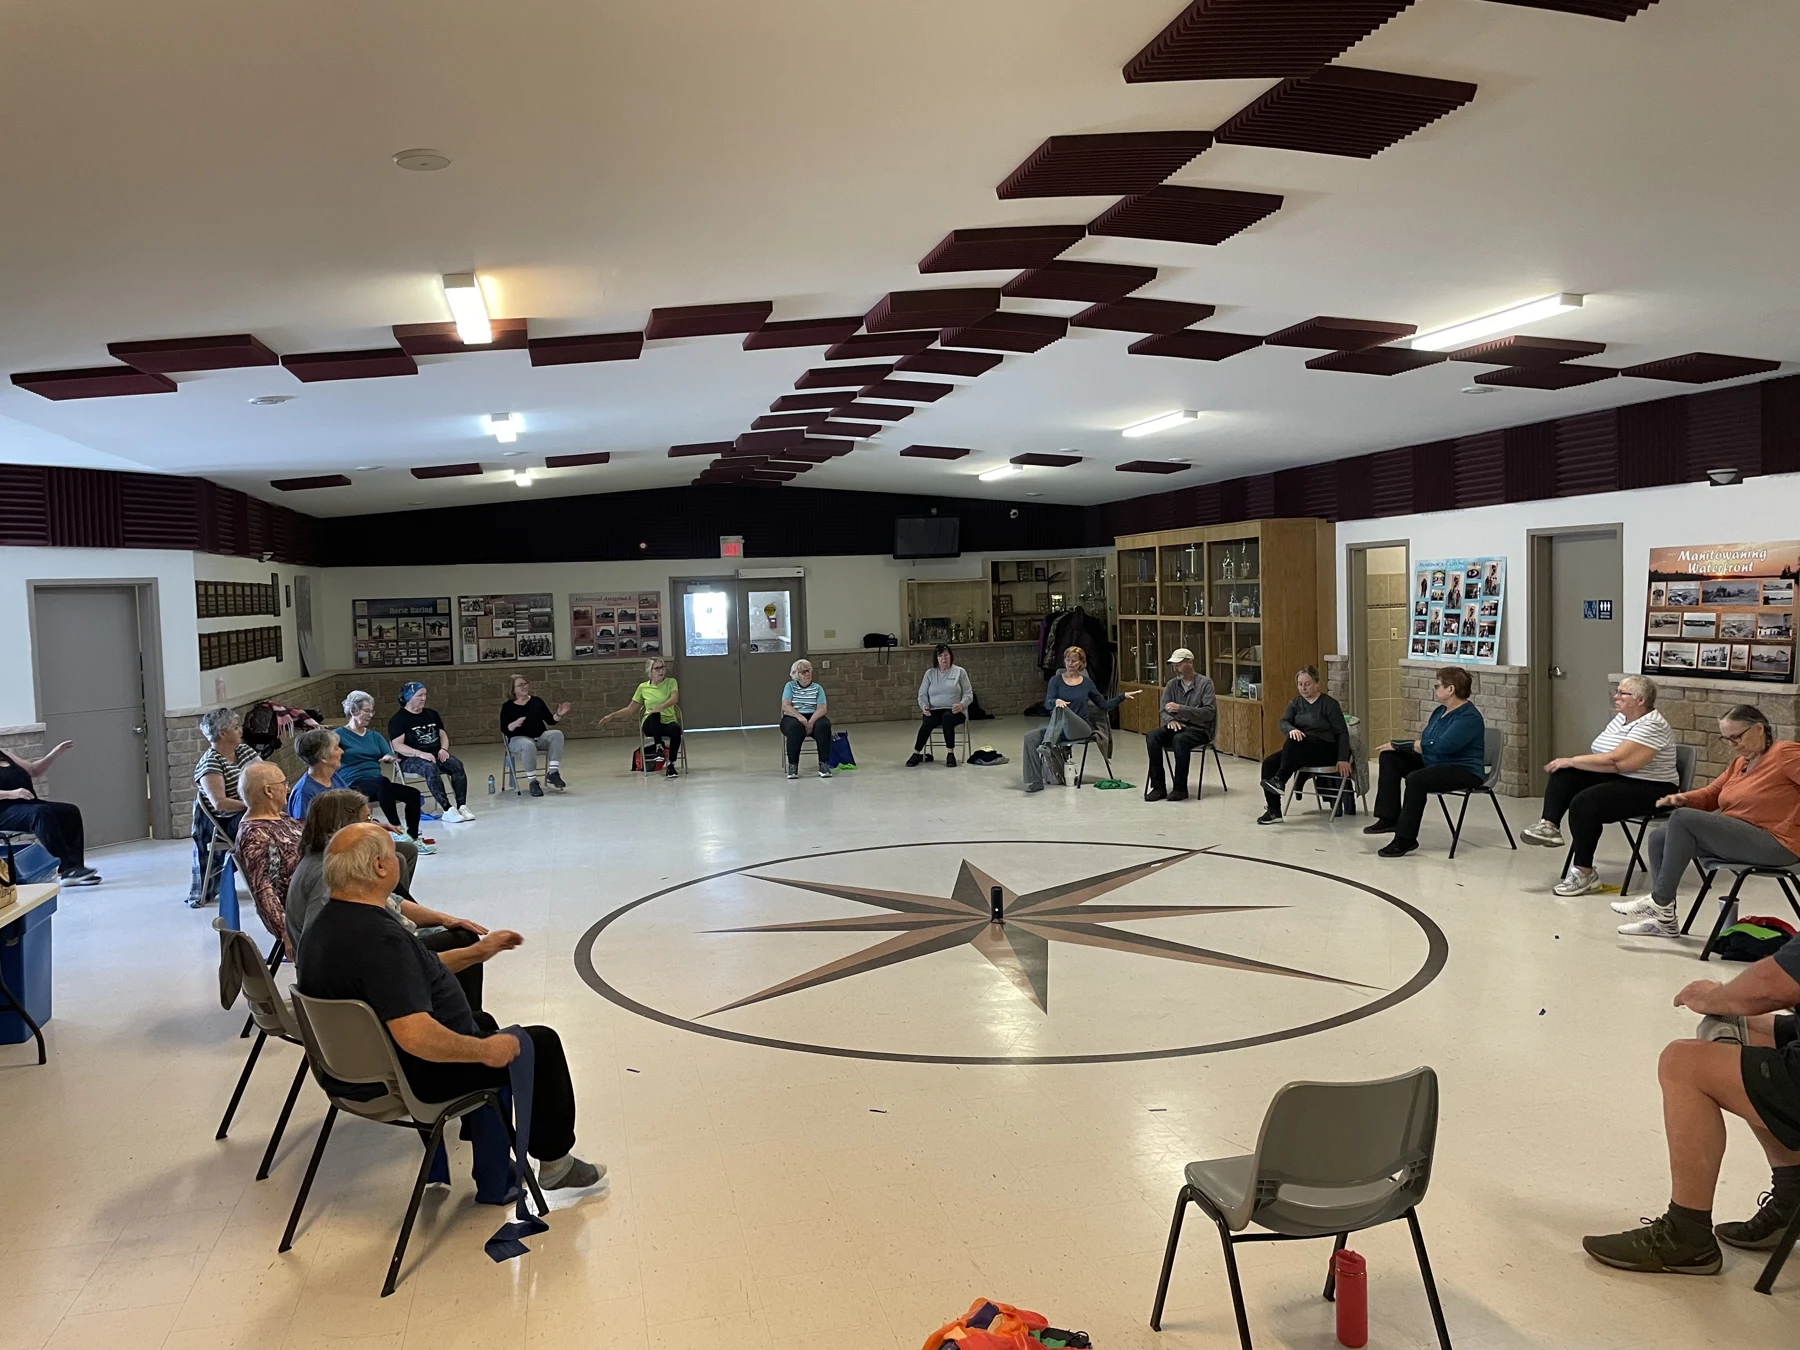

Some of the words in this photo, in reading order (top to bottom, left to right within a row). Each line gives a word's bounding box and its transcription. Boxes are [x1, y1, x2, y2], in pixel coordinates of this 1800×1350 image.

[1677, 549, 1767, 562] Manitowaning
[1688, 561, 1754, 575] Waterfront
[574, 595, 603, 603] Historical
[410, 606, 434, 614] Racing
